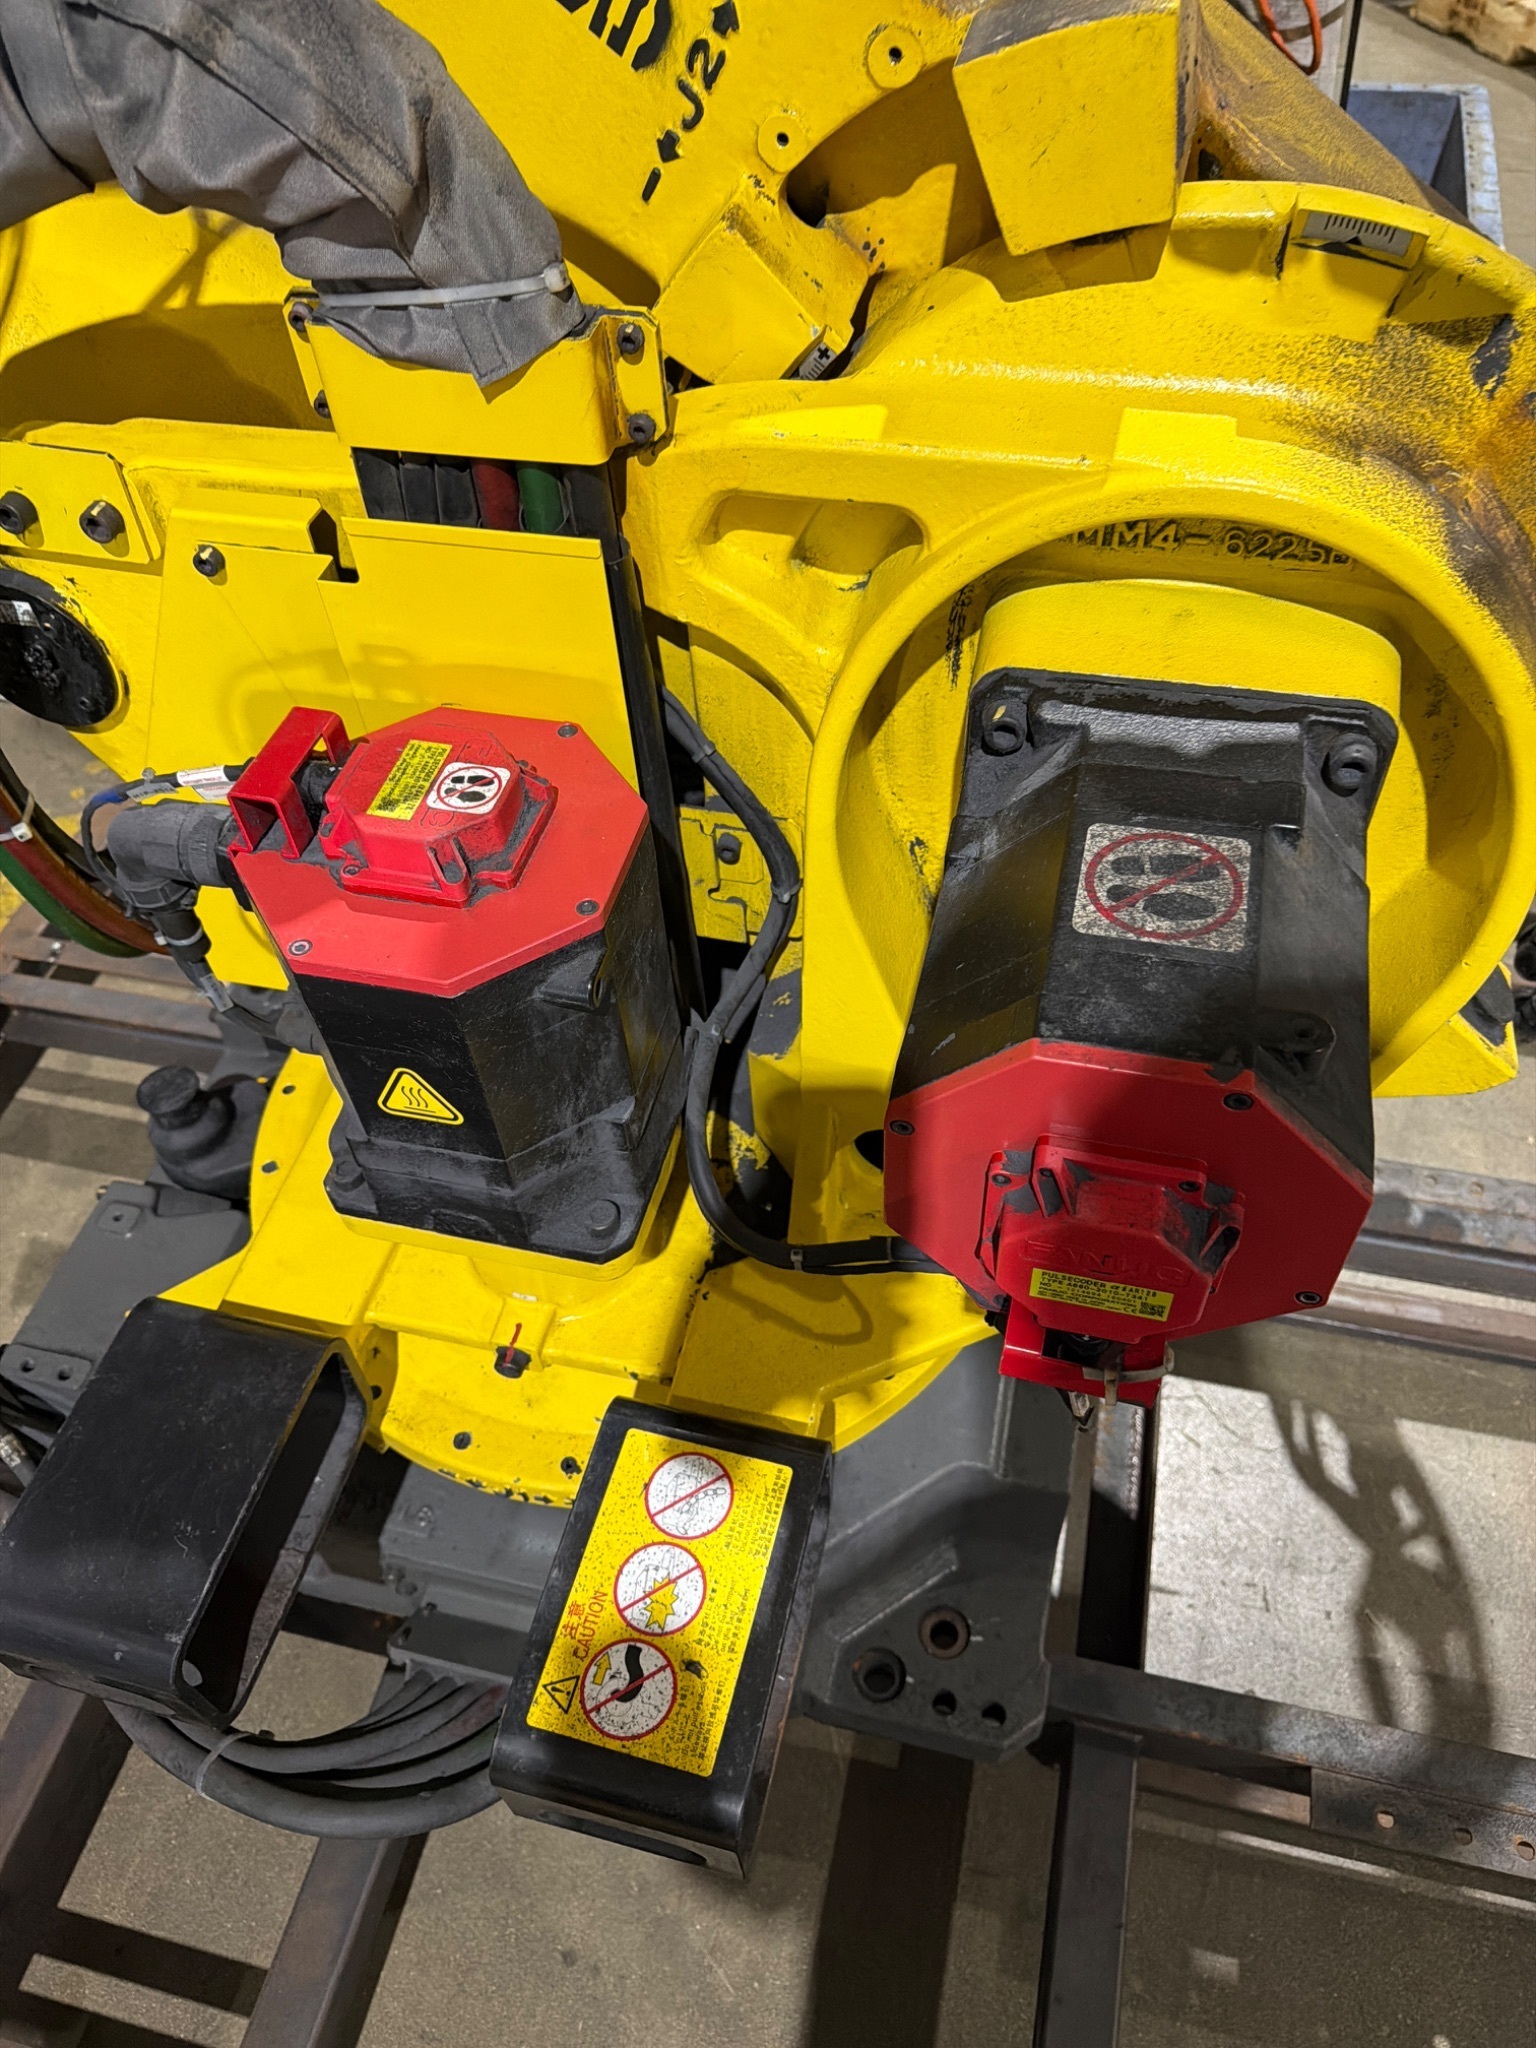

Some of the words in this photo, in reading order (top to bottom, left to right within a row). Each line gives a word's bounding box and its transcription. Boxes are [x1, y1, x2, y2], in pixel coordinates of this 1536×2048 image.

[677, 38, 726, 131] J2
[1040, 1270, 1107, 1288] PULSECODER
[1040, 1276, 1063, 1285] TYPE
[560, 1600, 586, 1641] 注意
[573, 1589, 609, 1660] CAUTION
